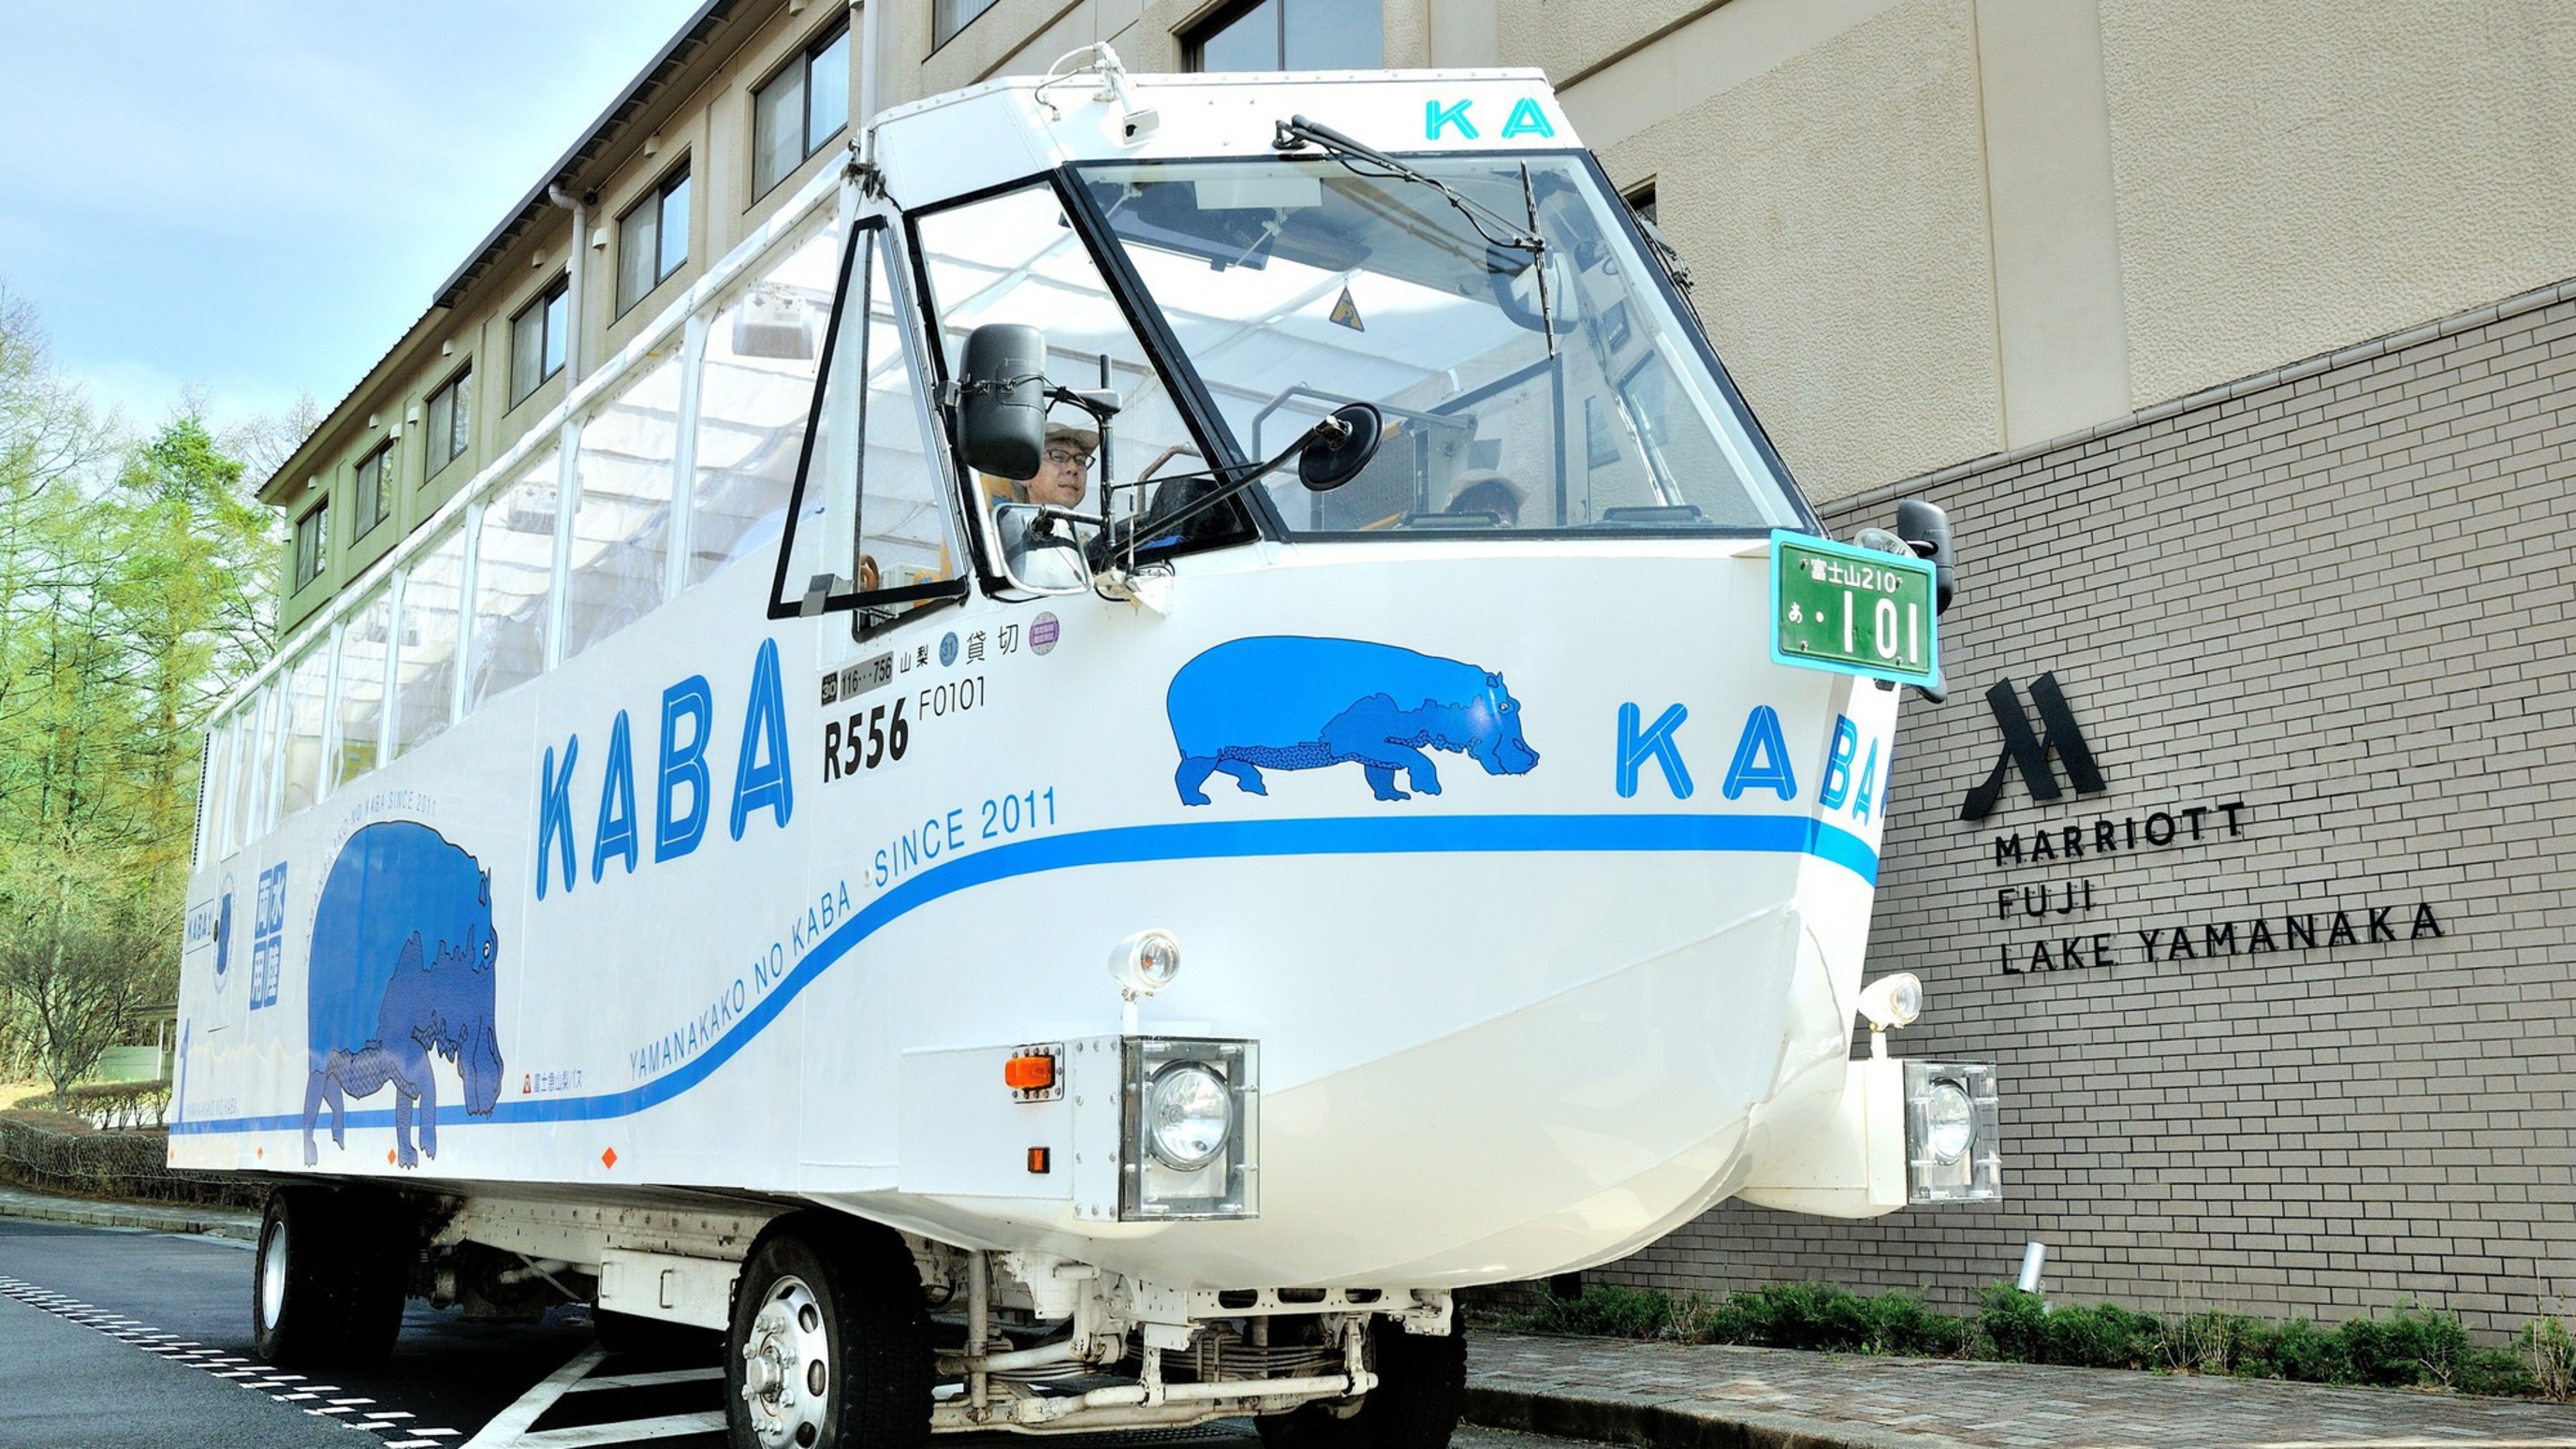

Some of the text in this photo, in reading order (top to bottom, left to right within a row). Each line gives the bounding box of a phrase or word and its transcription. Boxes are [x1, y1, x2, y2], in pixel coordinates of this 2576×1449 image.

[1426, 97, 1555, 141] KA
[1809, 558, 1896, 593] 富士山210
[966, 623, 1018, 666] 貸切
[918, 676, 985, 721] F0101
[824, 696, 909, 783] R556
[536, 637, 793, 901] KABA
[388, 790, 414, 810] SINCE
[416, 793, 436, 816] 2011
[1995, 801, 2245, 867] MARRIOTT
[1998, 879, 2097, 920] FUJI
[629, 786, 1056, 1082] YAMANAKAKO NO KABA SINCE 2011
[2000, 901, 2445, 975] LAKE YAMANAKA
